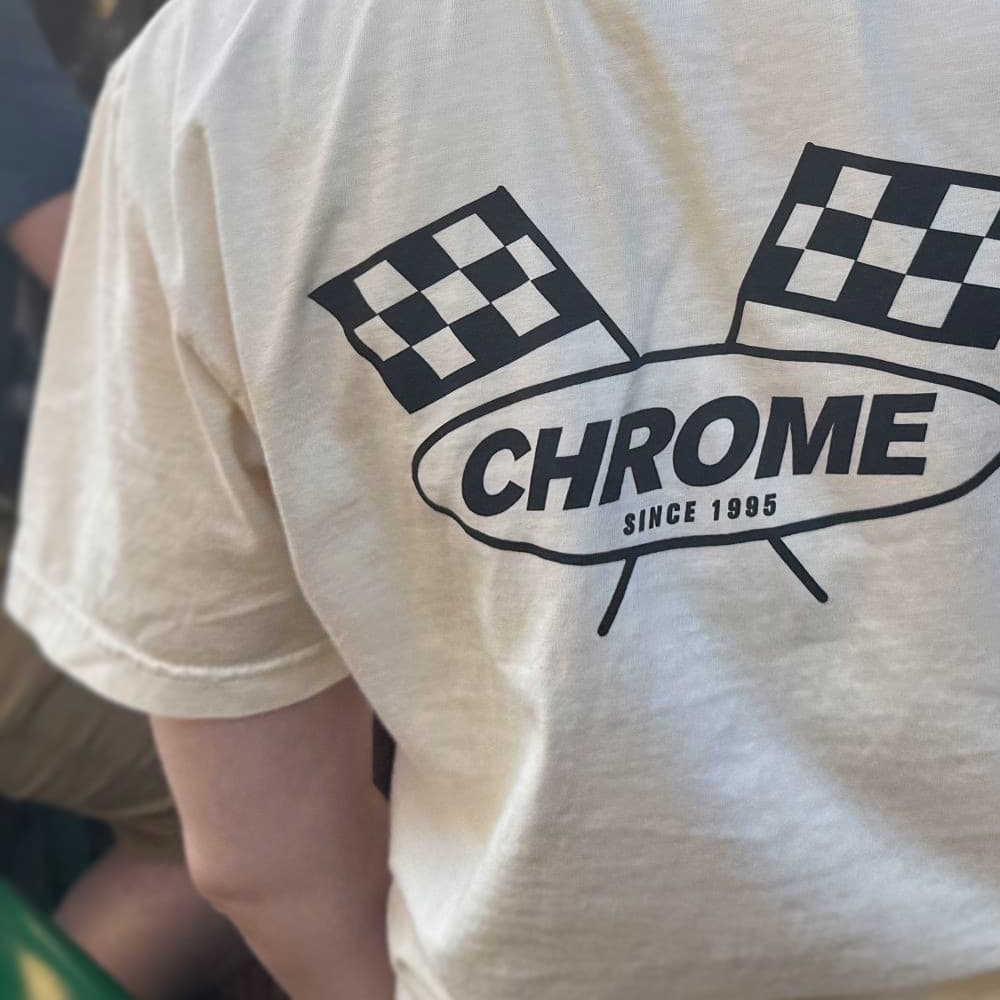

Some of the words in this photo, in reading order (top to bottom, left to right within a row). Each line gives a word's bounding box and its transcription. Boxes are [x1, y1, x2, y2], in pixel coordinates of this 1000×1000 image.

[462, 392, 938, 517] CHROME
[622, 500, 698, 536] SINCE
[711, 492, 778, 522] 1995
